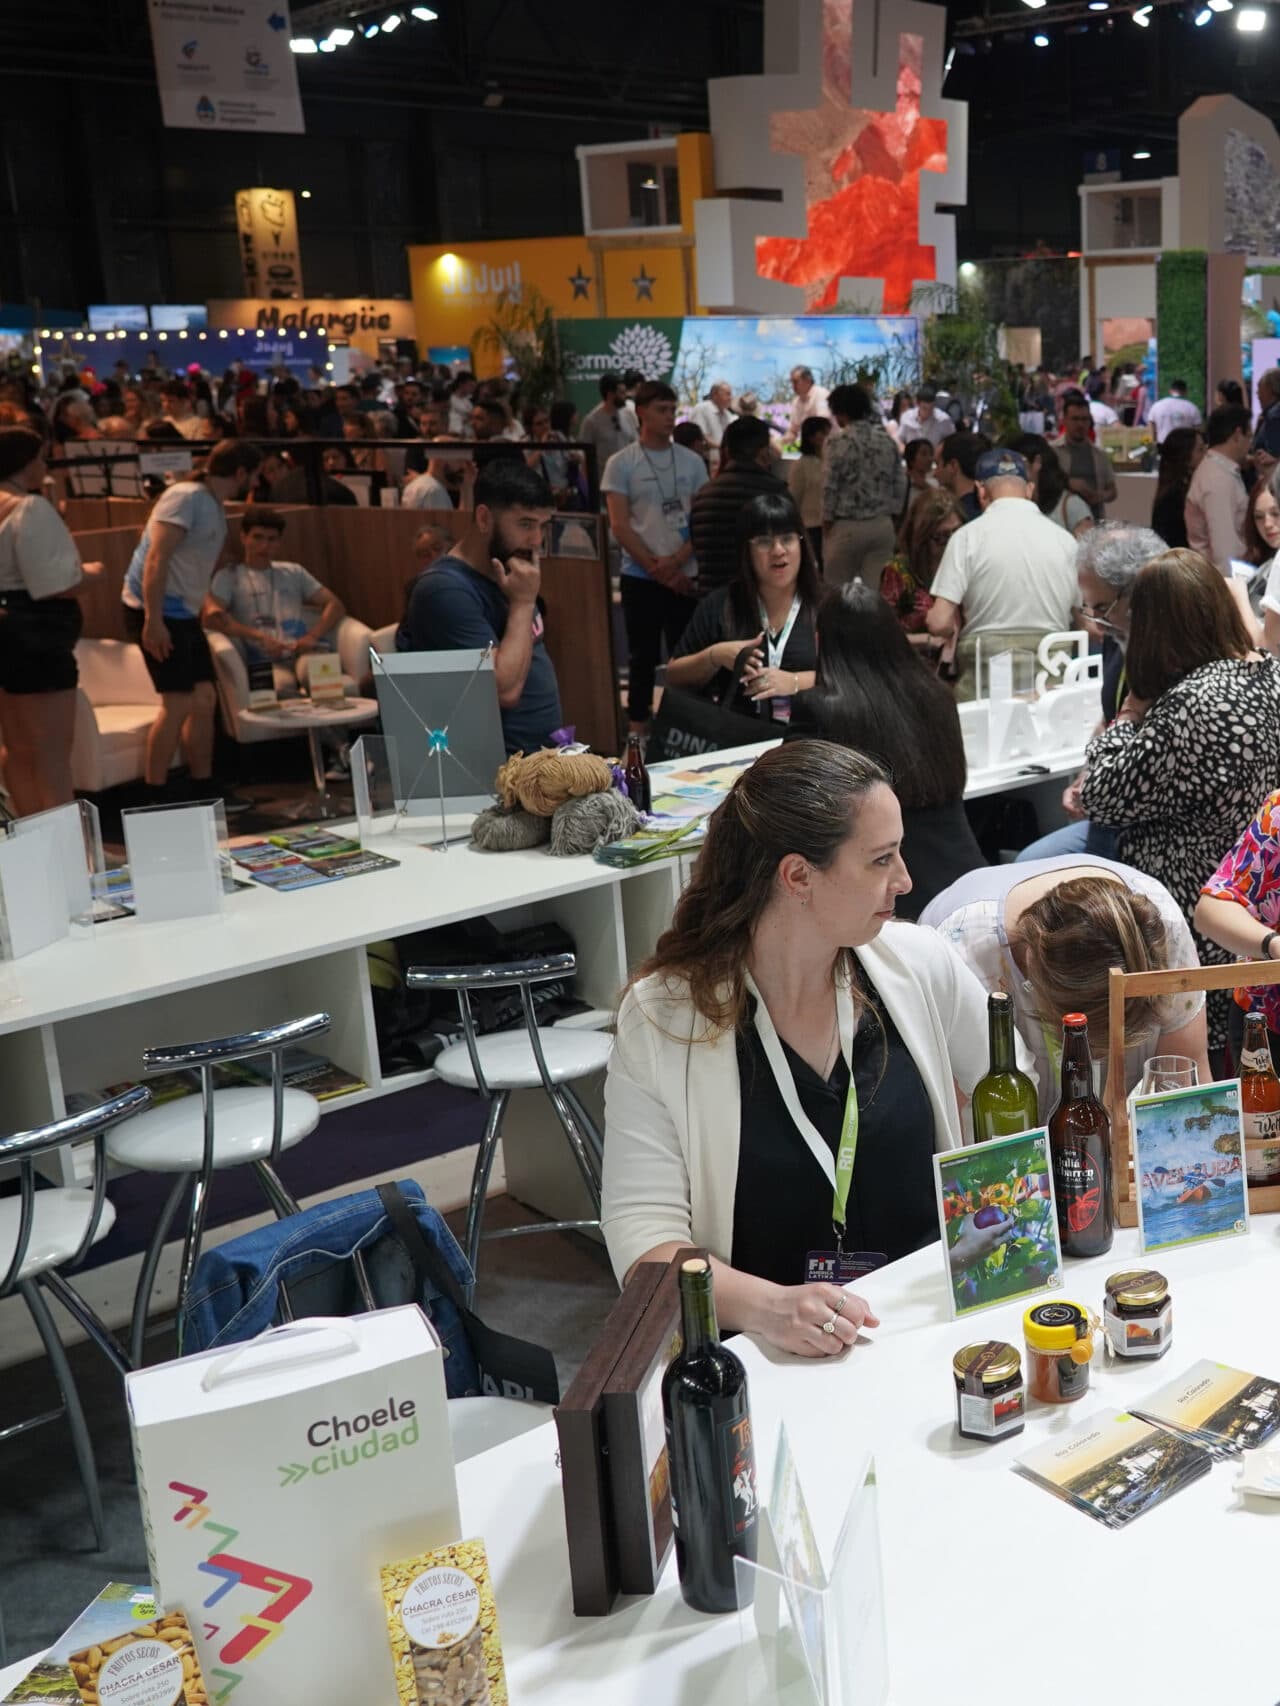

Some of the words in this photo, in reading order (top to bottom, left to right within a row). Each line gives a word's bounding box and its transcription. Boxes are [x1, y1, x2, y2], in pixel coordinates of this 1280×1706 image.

[257, 306, 391, 335] Malargüe
[307, 1397, 416, 1447] Choele
[311, 1416, 419, 1475] ciudad
[402, 1598, 442, 1616] CHACRA
[107, 1652, 137, 1677] FRUTOS
[136, 1646, 160, 1659] SECOS
[99, 1672, 143, 1696] CHACRA
